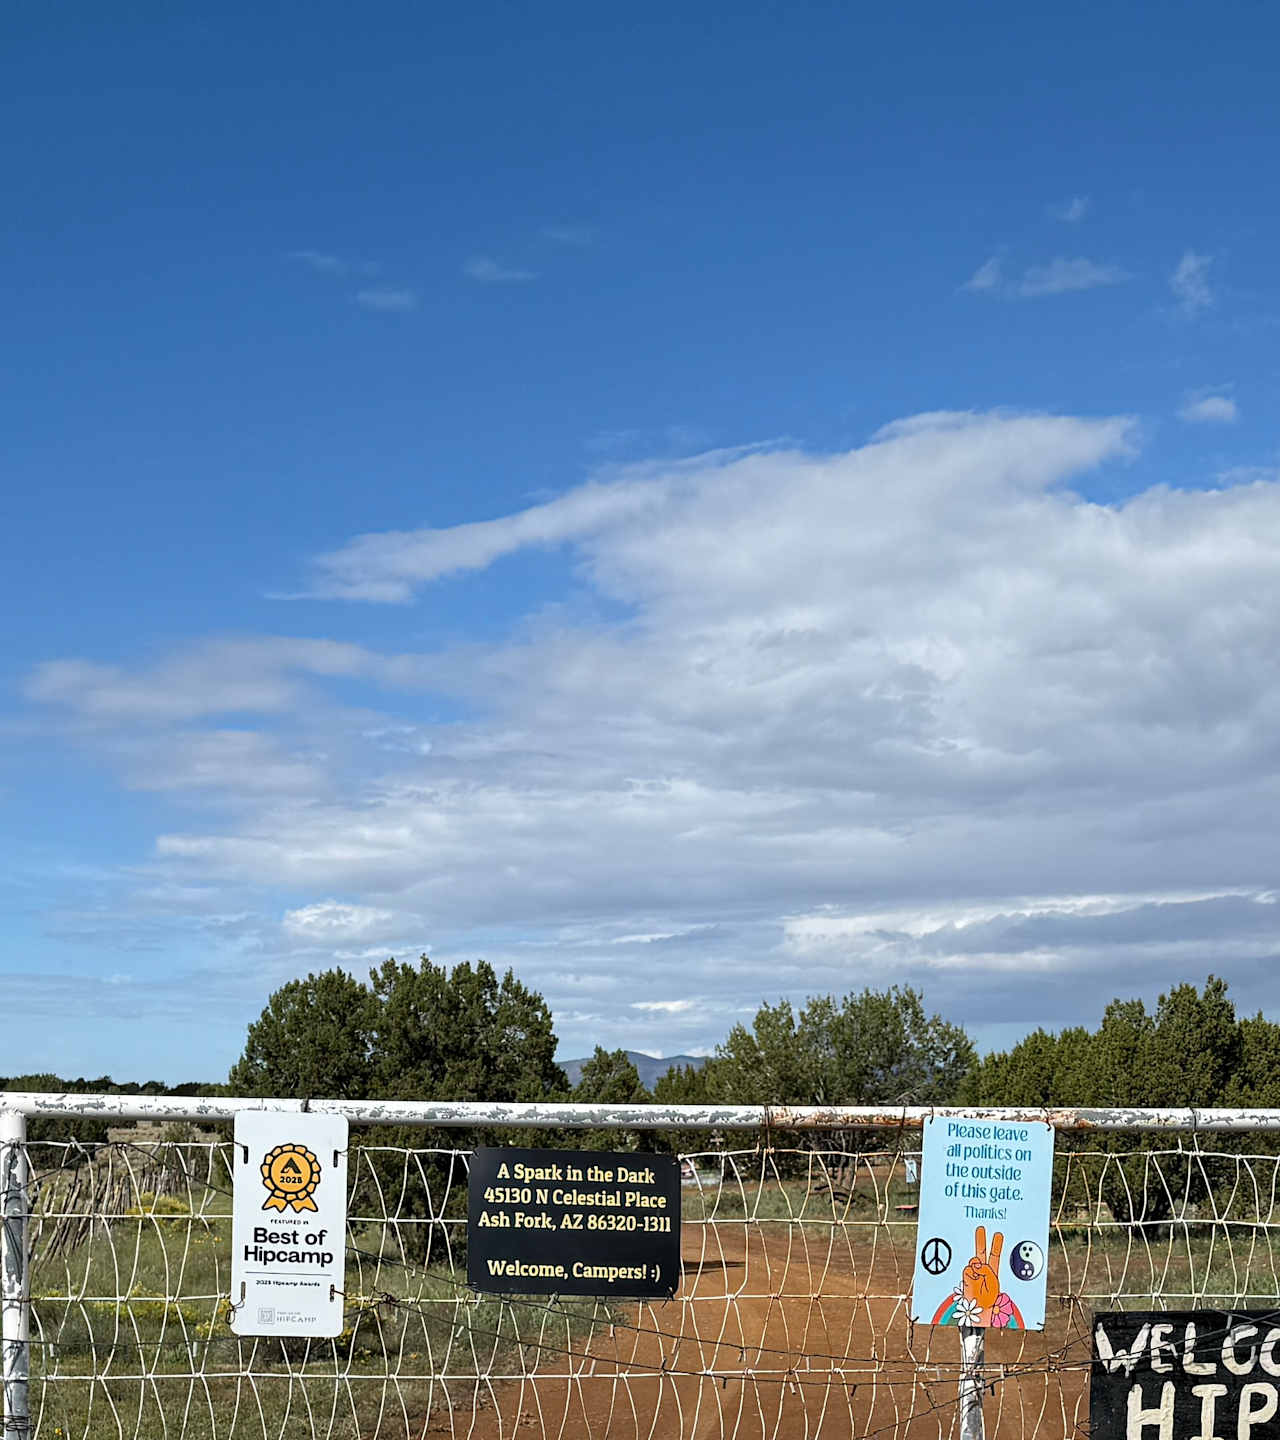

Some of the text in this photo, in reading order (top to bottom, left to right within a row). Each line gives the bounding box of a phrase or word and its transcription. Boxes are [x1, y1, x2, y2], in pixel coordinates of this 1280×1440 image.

[948, 1123, 1028, 1142] Please leave
[946, 1143, 1032, 1161] all politics on
[497, 1163, 655, 1184] A Spark in the Dark
[946, 1162, 1022, 1181] the outside
[483, 1187, 667, 1208] 45130 N Celestial Place
[944, 1182, 1024, 1203] of this gate.
[478, 1211, 671, 1233] Ash Fork, AZ 86320-1311
[964, 1205, 1007, 1220] Thanks!
[253, 1227, 328, 1245] Best of
[244, 1245, 333, 1268] Hipcamp
[487, 1259, 569, 1280] Welcome,
[572, 1262, 647, 1282] Campers!
